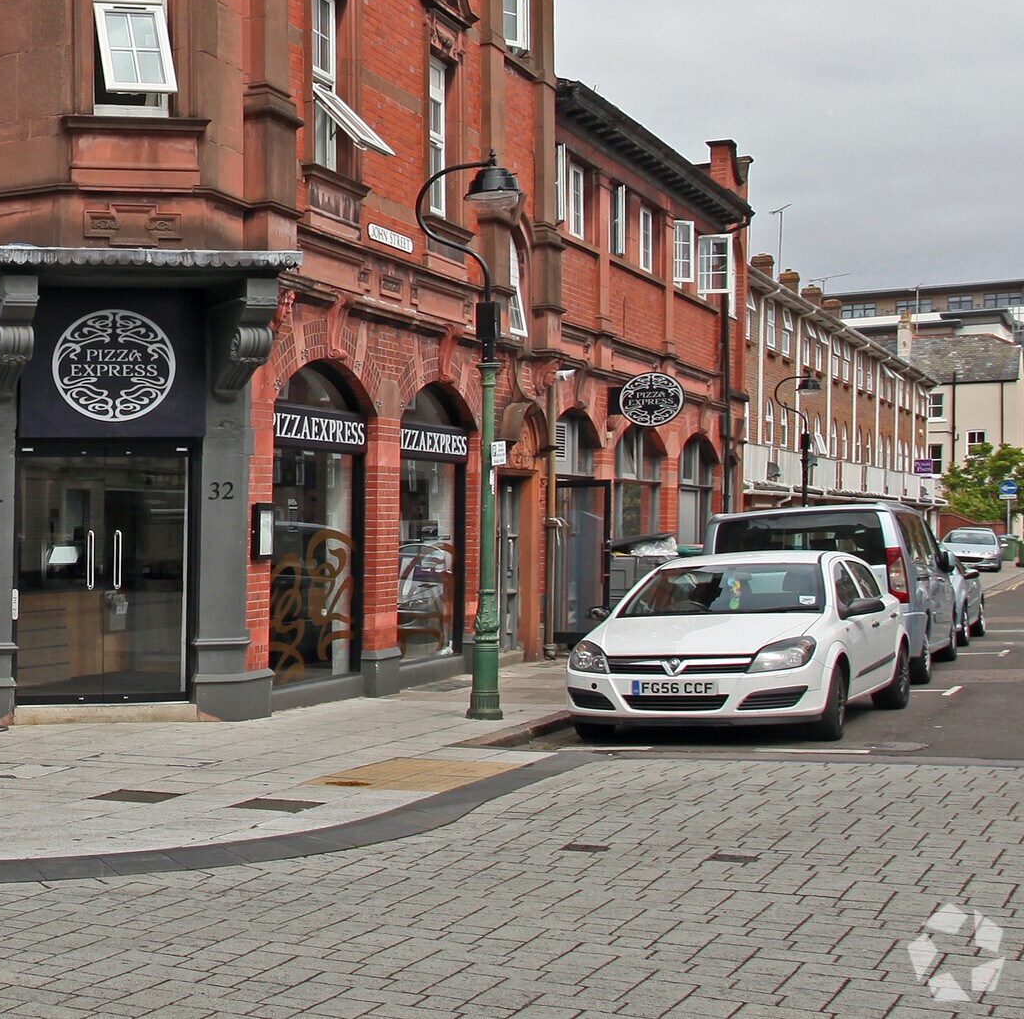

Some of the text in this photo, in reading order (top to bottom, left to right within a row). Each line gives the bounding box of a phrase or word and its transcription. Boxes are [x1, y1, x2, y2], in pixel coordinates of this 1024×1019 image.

[371, 225, 410, 251] JOHN STREET
[86, 349, 142, 361] PIZZA
[70, 364, 158, 377] EXPRESS
[636, 391, 666, 399] PIZZA
[628, 397, 674, 406] EXPRESS
[400, 428, 467, 456] IZZAEXPRESS
[208, 482, 234, 500] 32
[641, 683, 713, 694] FG56 CCF
